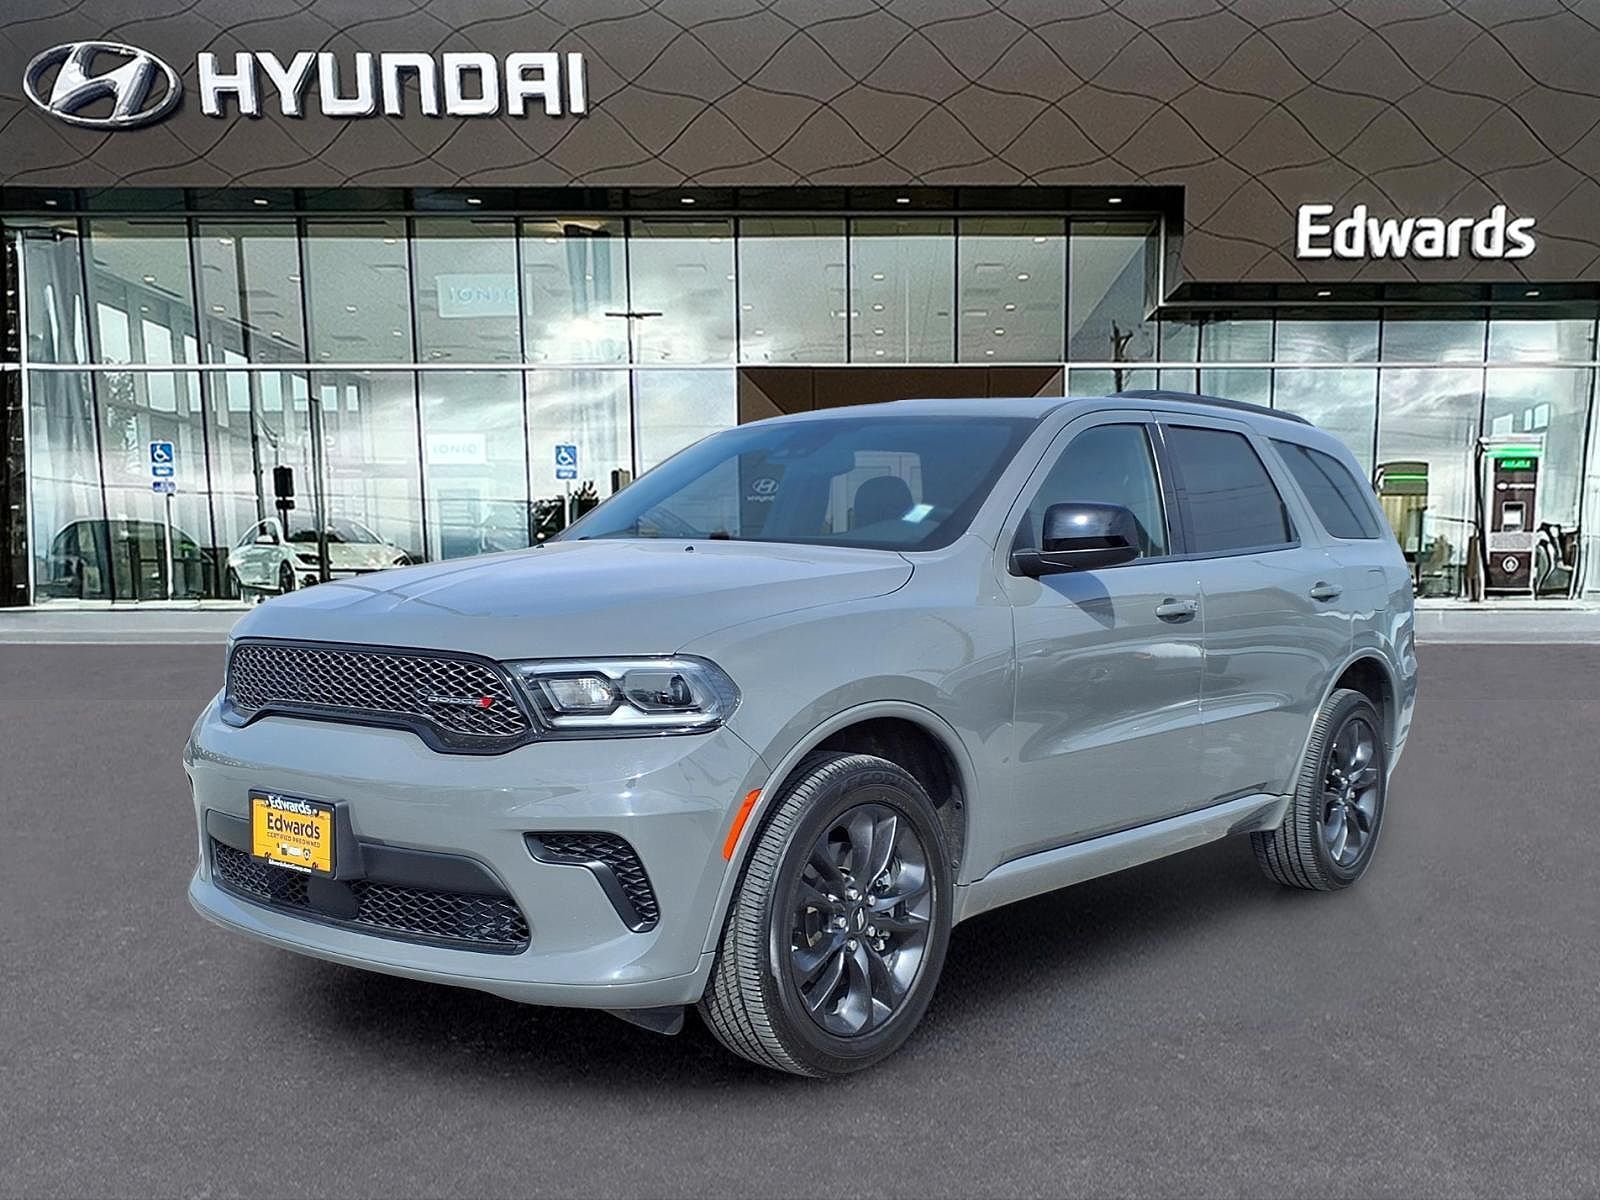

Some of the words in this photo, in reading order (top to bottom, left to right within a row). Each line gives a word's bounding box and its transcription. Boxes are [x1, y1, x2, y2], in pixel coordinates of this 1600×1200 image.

[197, 51, 590, 118] HYUNDAI
[1297, 204, 1536, 259] Edwards
[268, 795, 312, 815] Edwards
[267, 812, 320, 840] Edwards
